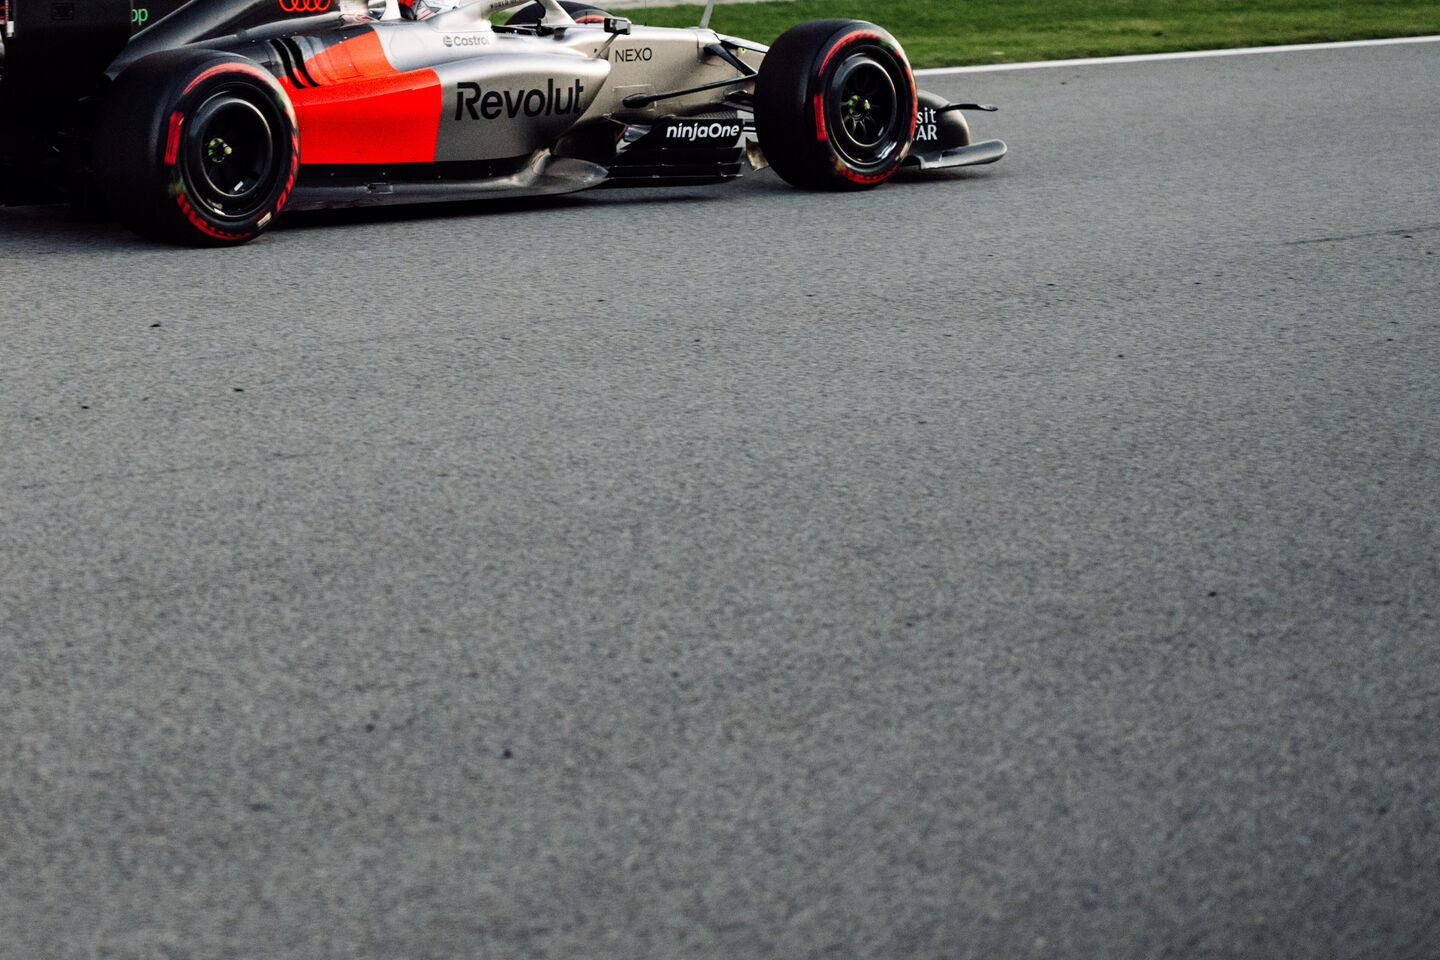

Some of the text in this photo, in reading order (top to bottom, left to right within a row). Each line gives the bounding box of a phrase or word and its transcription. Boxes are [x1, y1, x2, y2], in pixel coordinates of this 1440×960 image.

[615, 47, 653, 62] NEXO
[455, 78, 584, 121] Revolut
[916, 106, 937, 124] sit
[666, 121, 740, 141] ninjaOne
